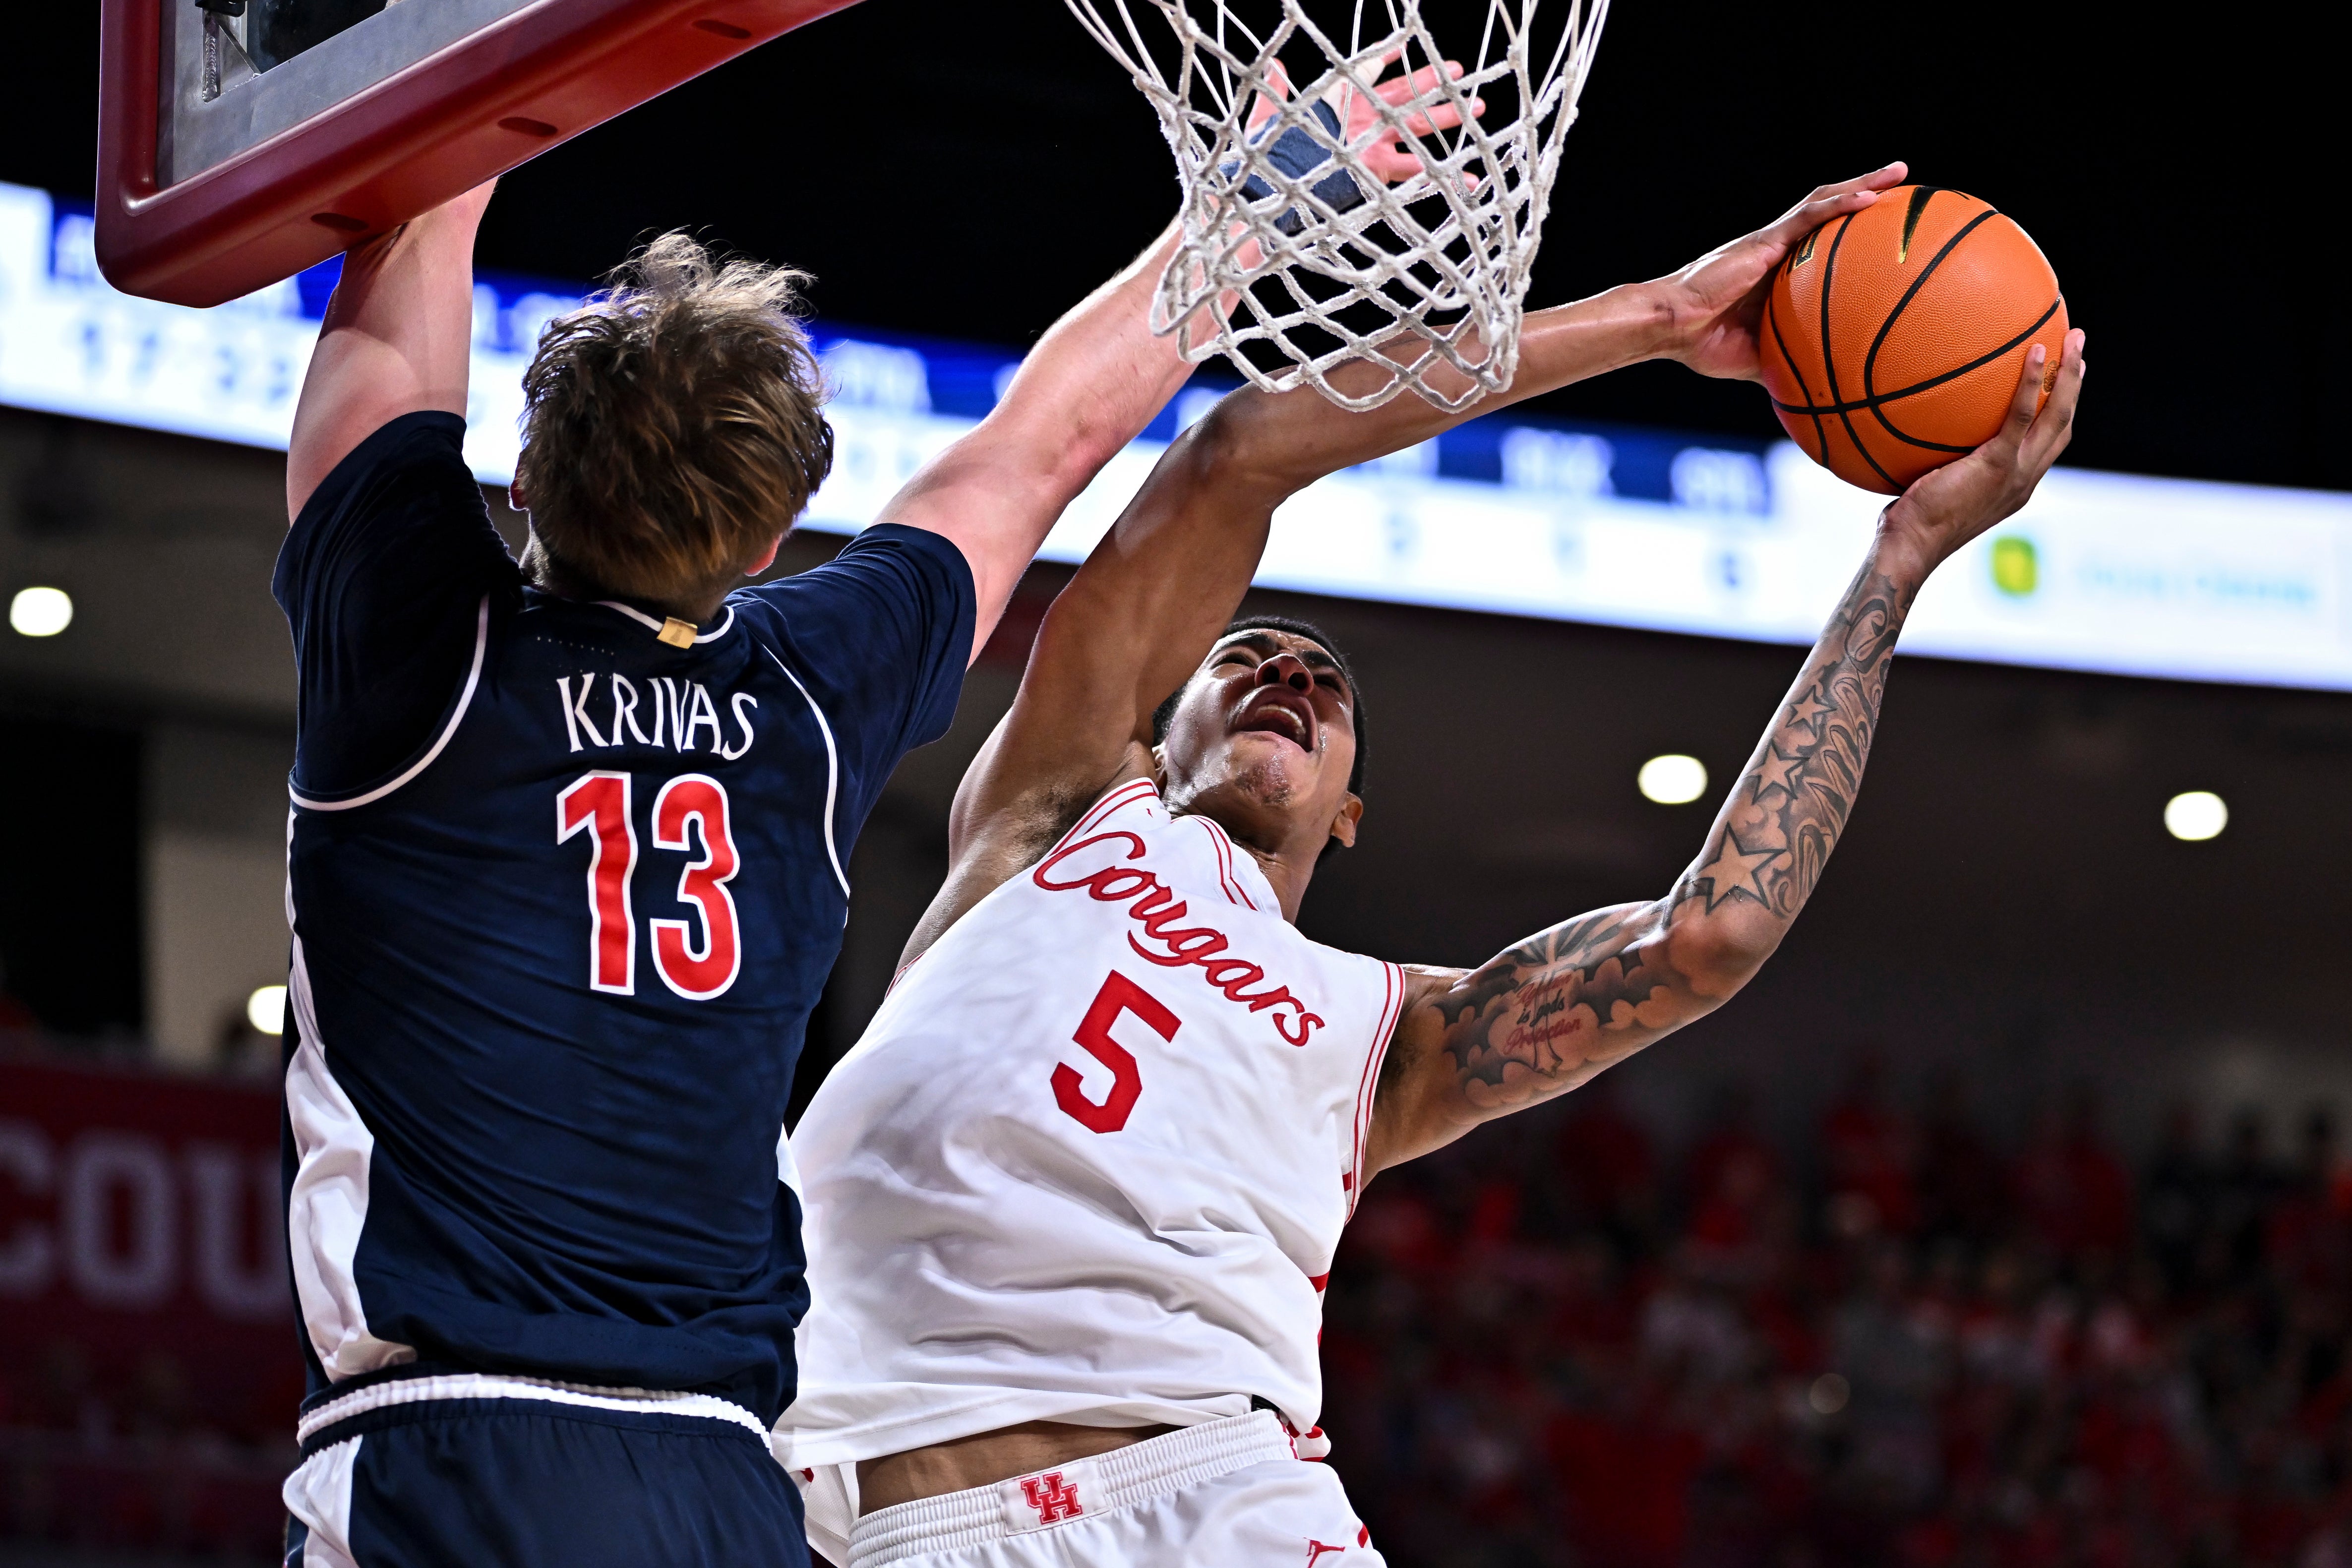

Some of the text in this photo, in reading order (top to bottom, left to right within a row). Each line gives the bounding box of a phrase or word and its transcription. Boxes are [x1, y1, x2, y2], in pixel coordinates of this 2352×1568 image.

[556, 672, 758, 761] KRIVAS
[556, 769, 741, 1001] 13
[1032, 831, 1326, 1047] Cougars
[1050, 969, 1182, 1135] 5
